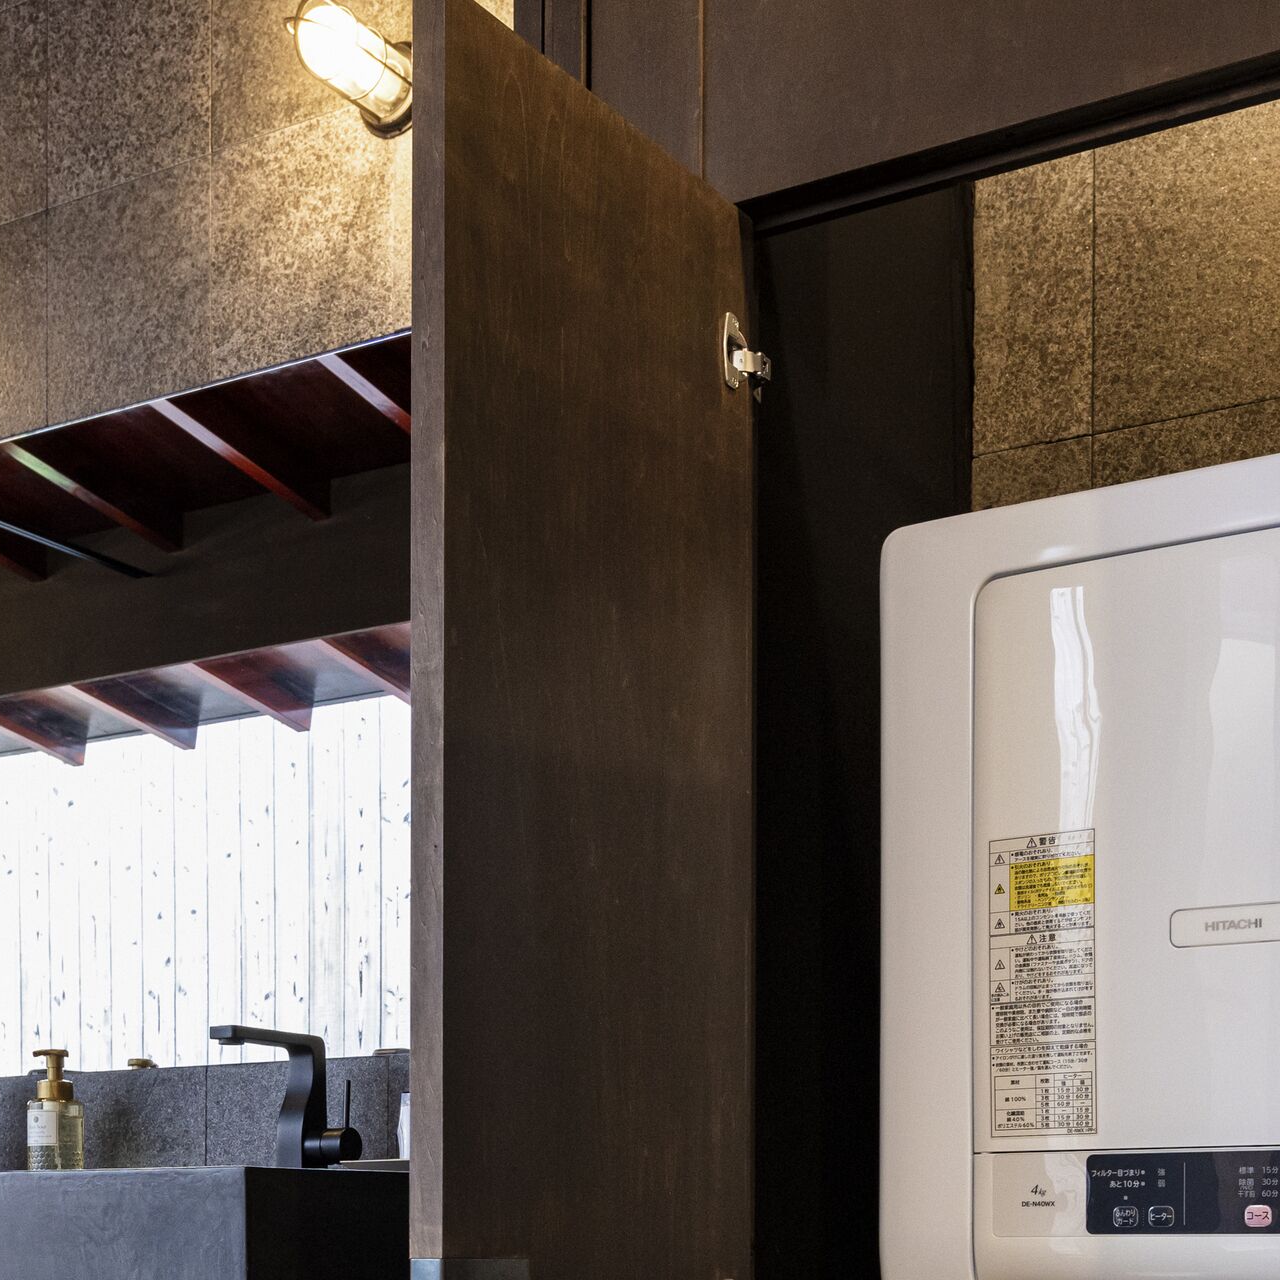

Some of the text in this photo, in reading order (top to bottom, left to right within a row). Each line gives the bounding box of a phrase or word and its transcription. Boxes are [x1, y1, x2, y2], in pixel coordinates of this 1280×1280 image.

[1039, 836, 1057, 846] 警告
[1205, 918, 1263, 932] HITACHI
[1039, 934, 1057, 943] 注意
[1091, 1168, 1141, 1178] フィルター目づまり
[1157, 1168, 1166, 1177] 強
[1262, 1166, 1279, 1174] 15分
[1109, 1180, 1140, 1189] あと10分
[1262, 1178, 1279, 1186] 30分
[1261, 1189, 1279, 1198] 60分
[1021, 1200, 1056, 1208] DE-N40WX
[1150, 1212, 1172, 1222] ヒーター
[1246, 1211, 1270, 1220] コース
